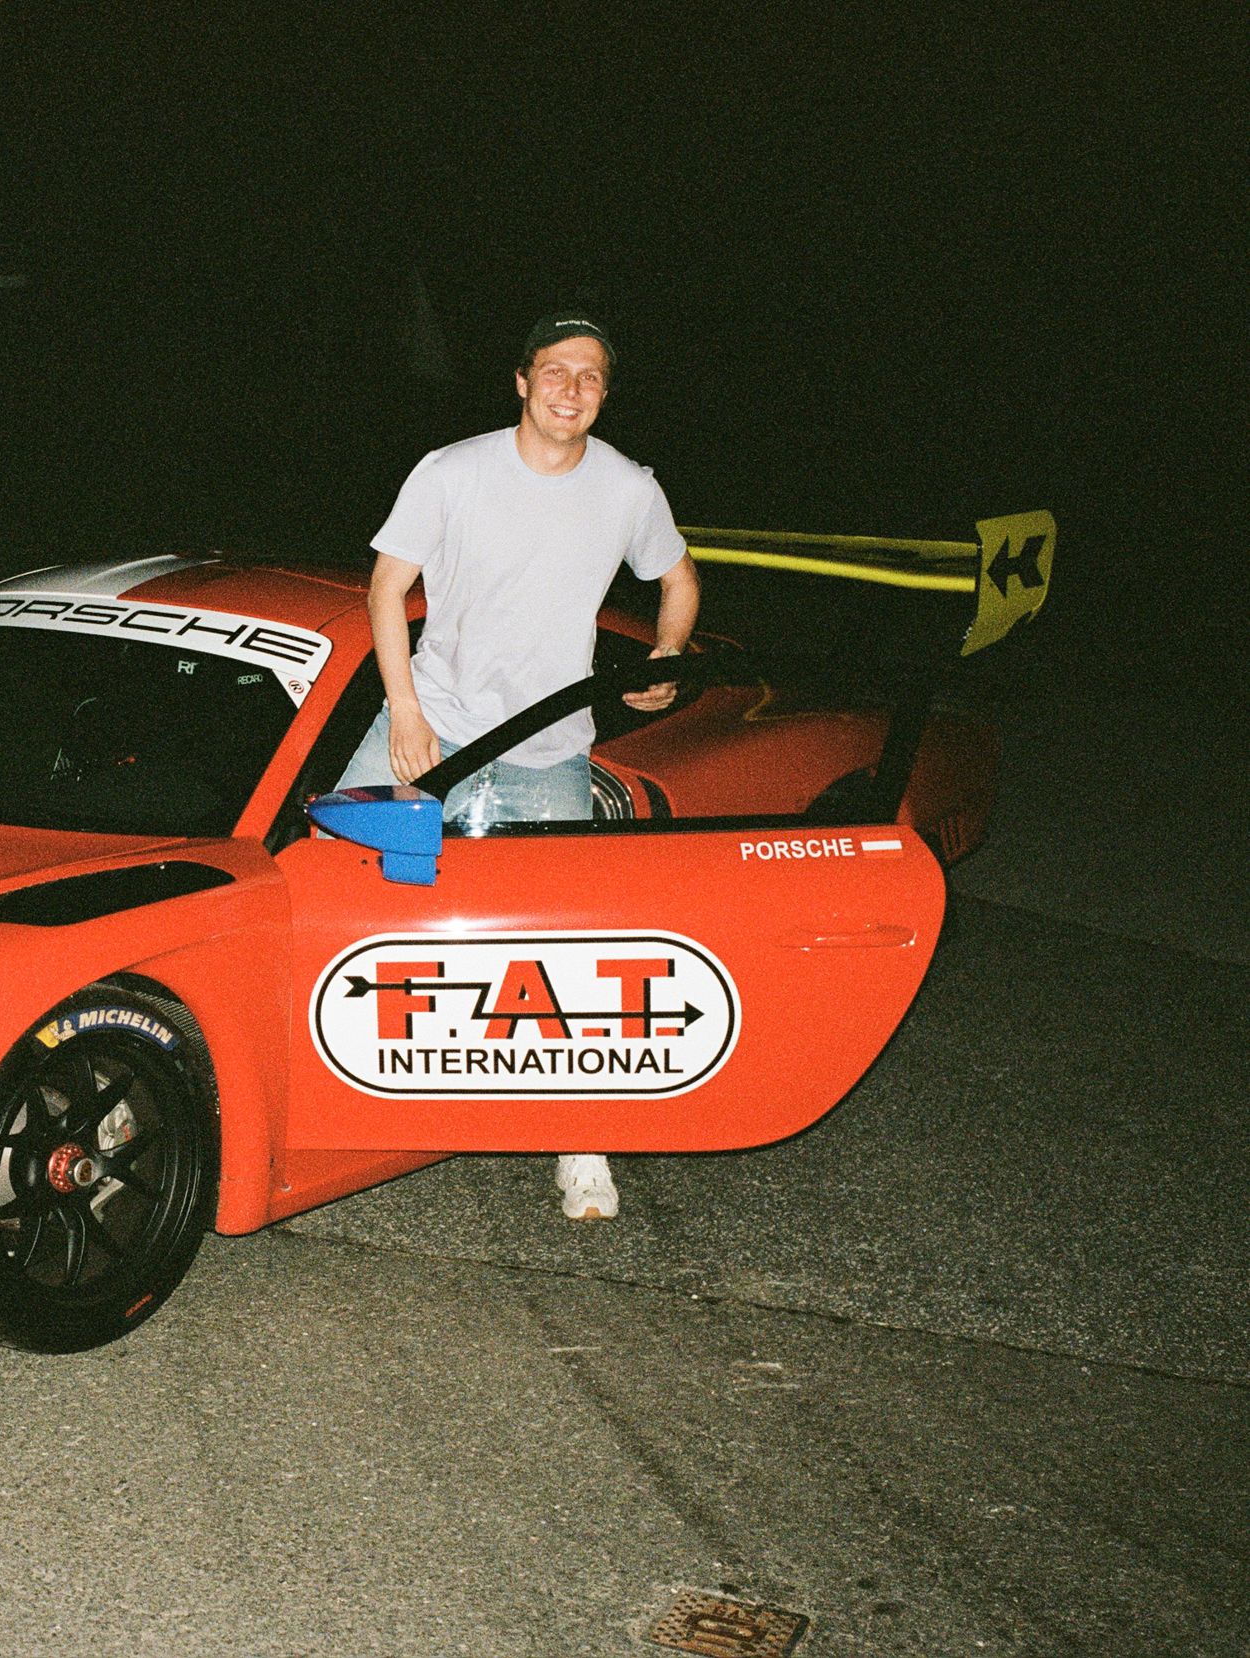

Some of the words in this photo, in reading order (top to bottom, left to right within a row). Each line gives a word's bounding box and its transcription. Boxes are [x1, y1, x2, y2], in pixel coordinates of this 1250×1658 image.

[237, 673, 263, 685] RECARO
[740, 837, 856, 861] PORSCHE
[375, 958, 686, 1040] F.A.T.
[78, 1009, 174, 1045] MICHELIN
[377, 1047, 685, 1075] INTERNATIONAL
